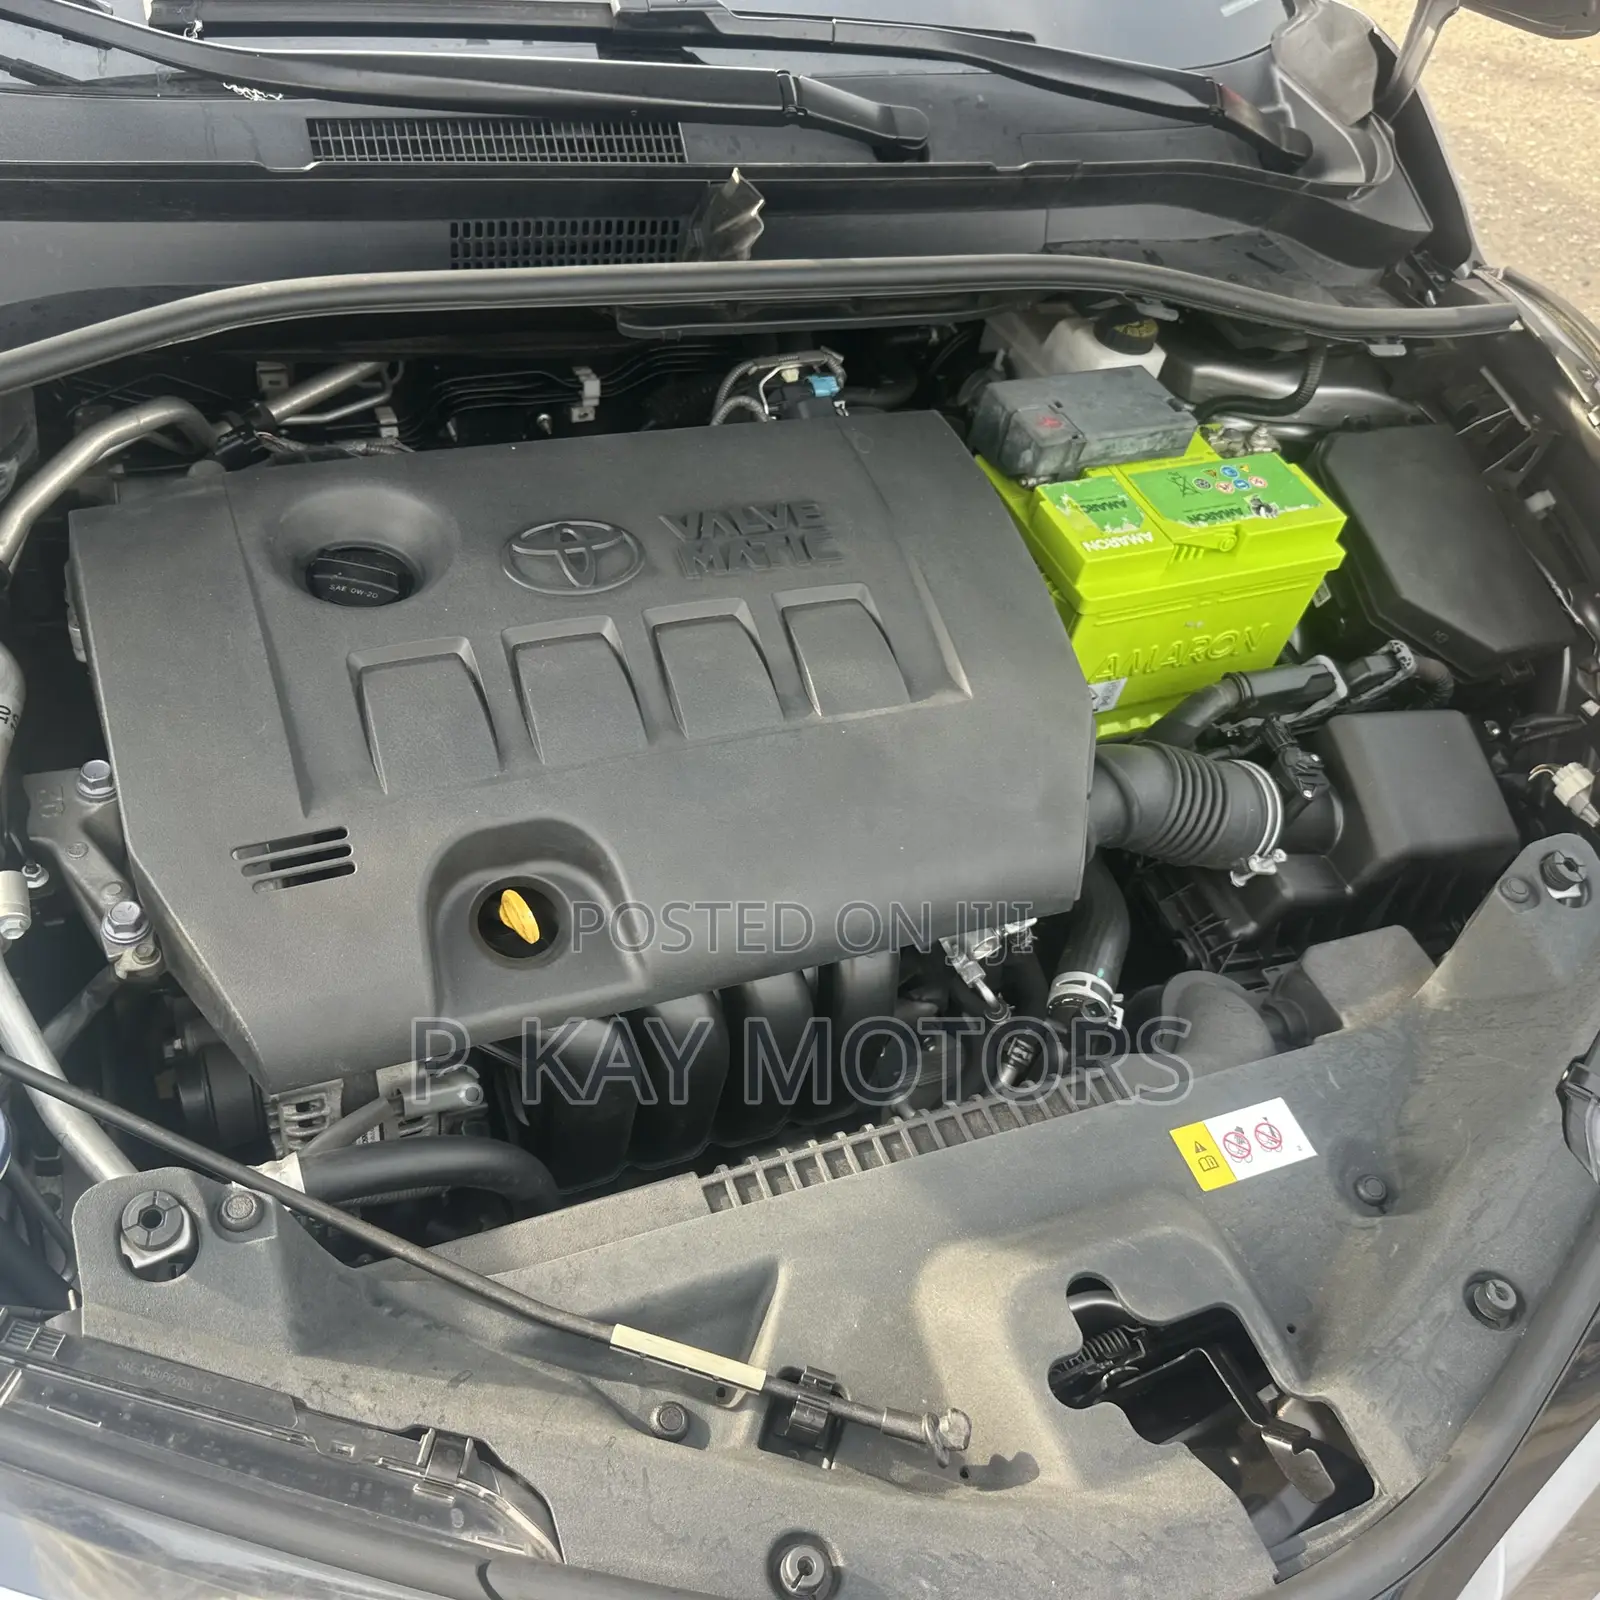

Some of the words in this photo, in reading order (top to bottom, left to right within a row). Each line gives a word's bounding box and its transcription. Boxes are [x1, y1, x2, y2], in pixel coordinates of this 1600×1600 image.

[658, 501, 823, 543] VALVE
[1082, 530, 1154, 553] AMARON
[328, 583, 348, 593] SAE
[350, 587, 379, 600] 0W-20
[1088, 622, 1273, 684] AMARON
